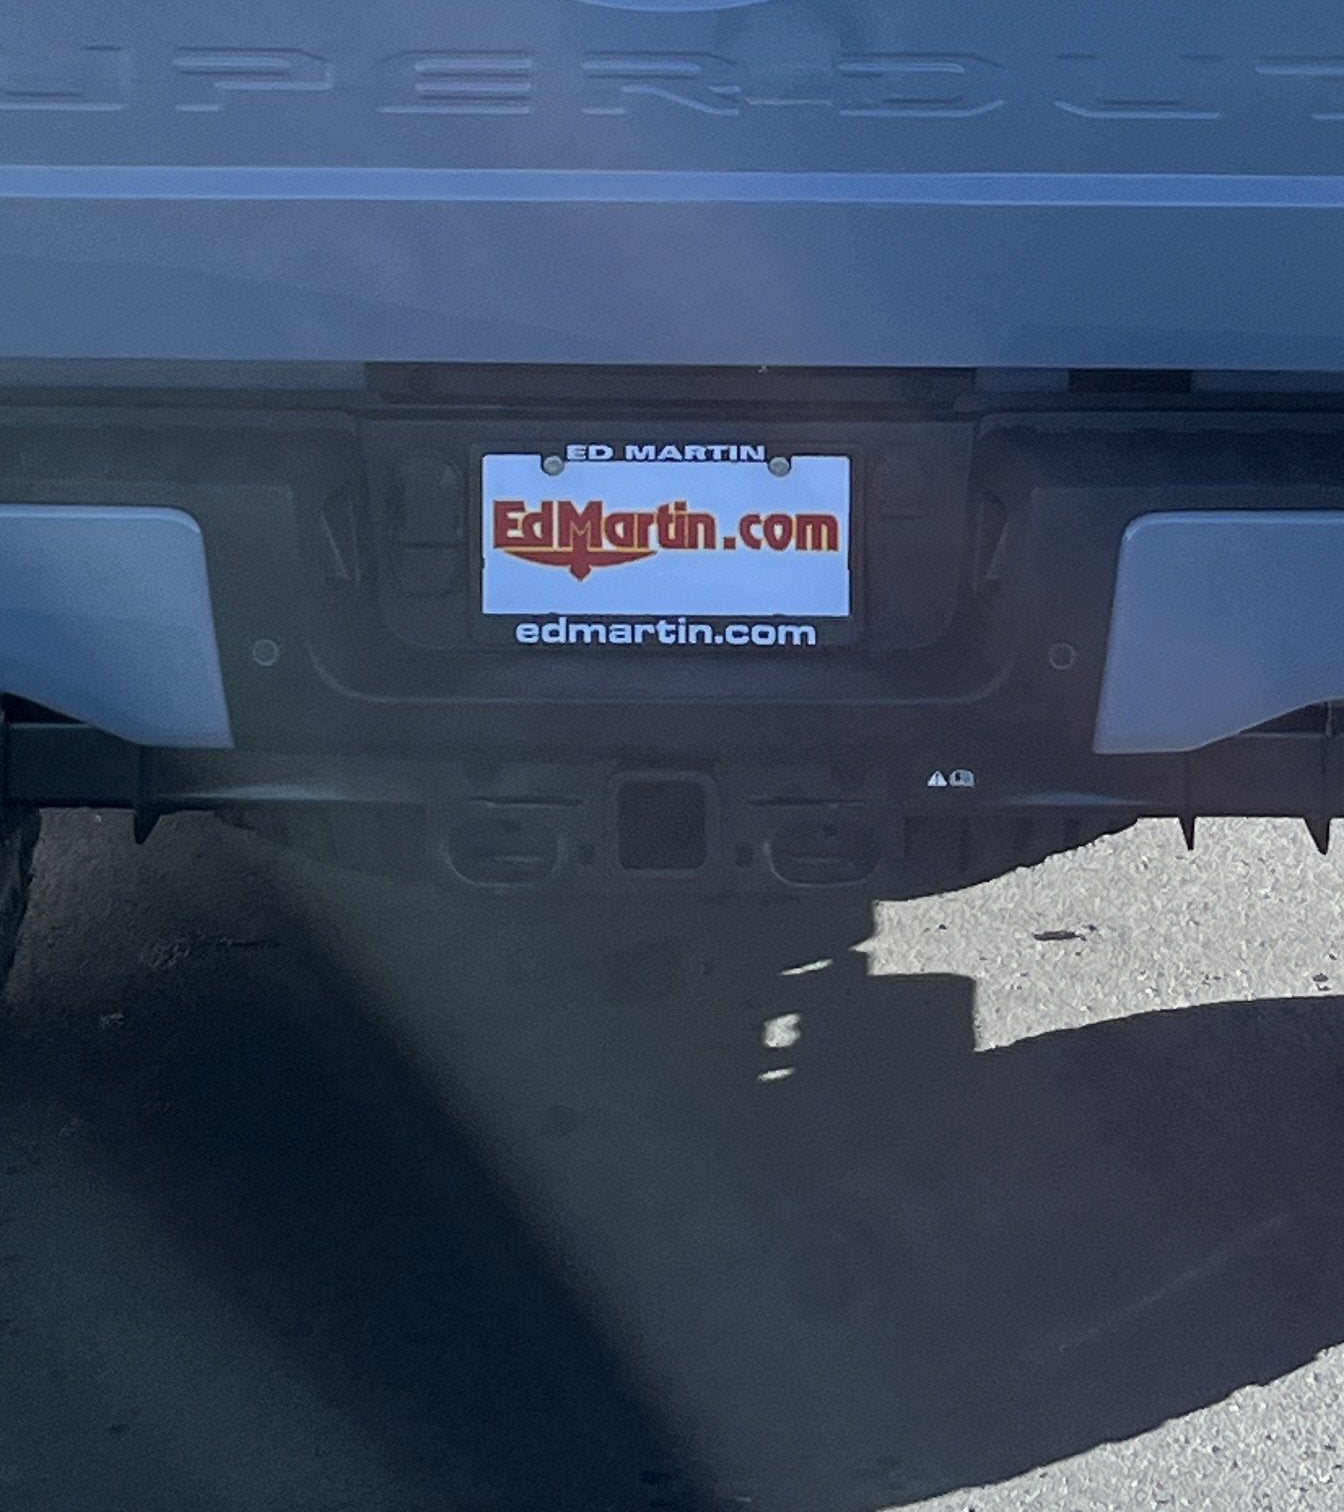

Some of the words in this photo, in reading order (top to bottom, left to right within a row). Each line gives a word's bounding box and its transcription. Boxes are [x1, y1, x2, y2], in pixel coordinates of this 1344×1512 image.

[565, 444, 614, 461] ED
[624, 444, 767, 462] MARTIN
[492, 499, 839, 552] EdMartin.com
[515, 617, 816, 646] edmartin.com
